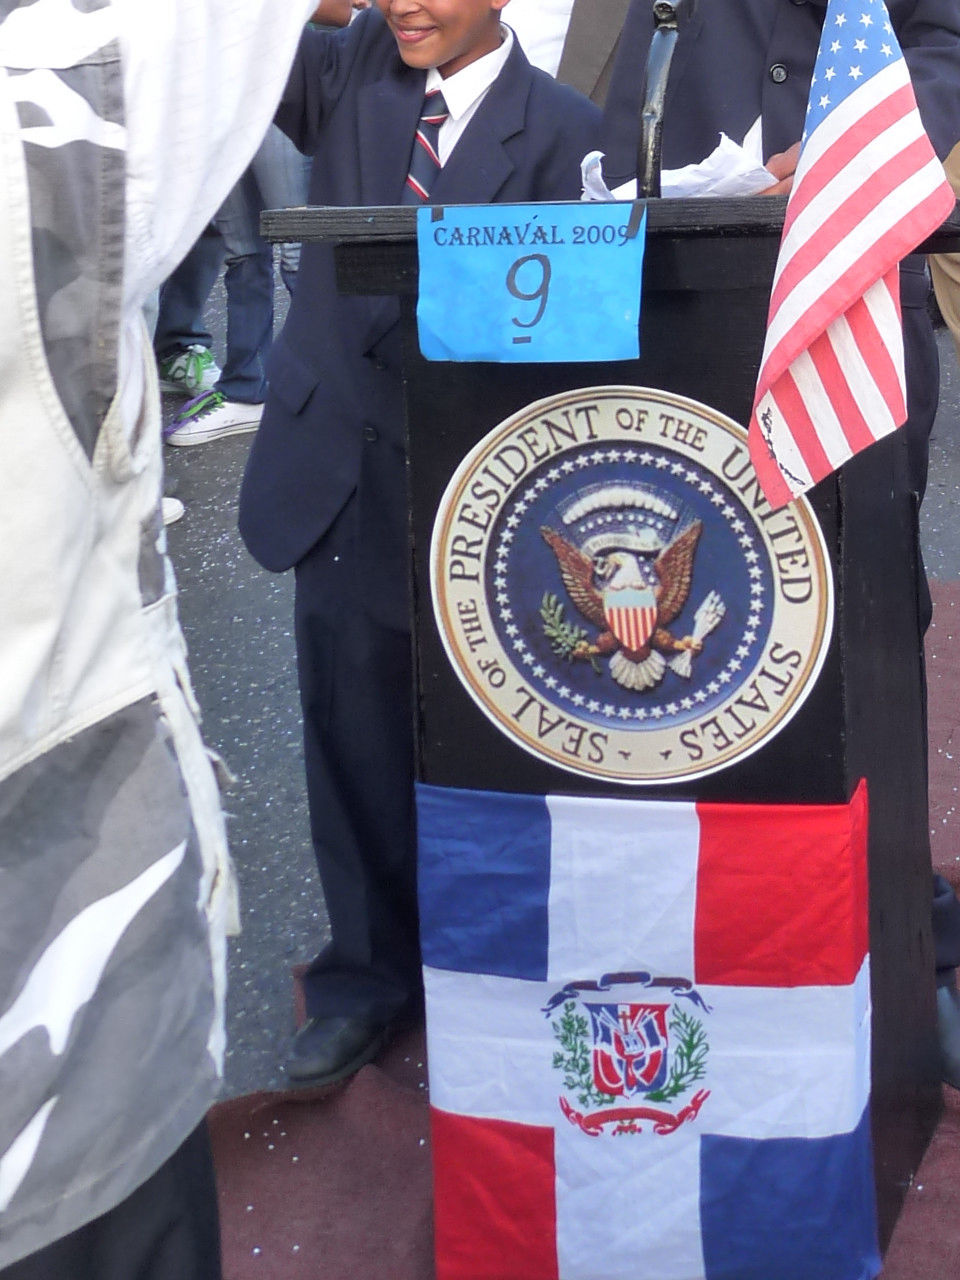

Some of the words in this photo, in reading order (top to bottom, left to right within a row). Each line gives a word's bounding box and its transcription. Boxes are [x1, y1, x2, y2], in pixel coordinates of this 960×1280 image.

[571, 224, 631, 247] 2009
[505, 252, 552, 329] 9
[614, 407, 649, 433] OF
[658, 413, 708, 453] THE
[449, 405, 601, 585] PRESIDENT
[720, 443, 814, 605] UNITED
[457, 598, 488, 654] THE
[478, 657, 507, 689] OF
[680, 642, 802, 763] STATES
[511, 685, 610, 765] SEAL
